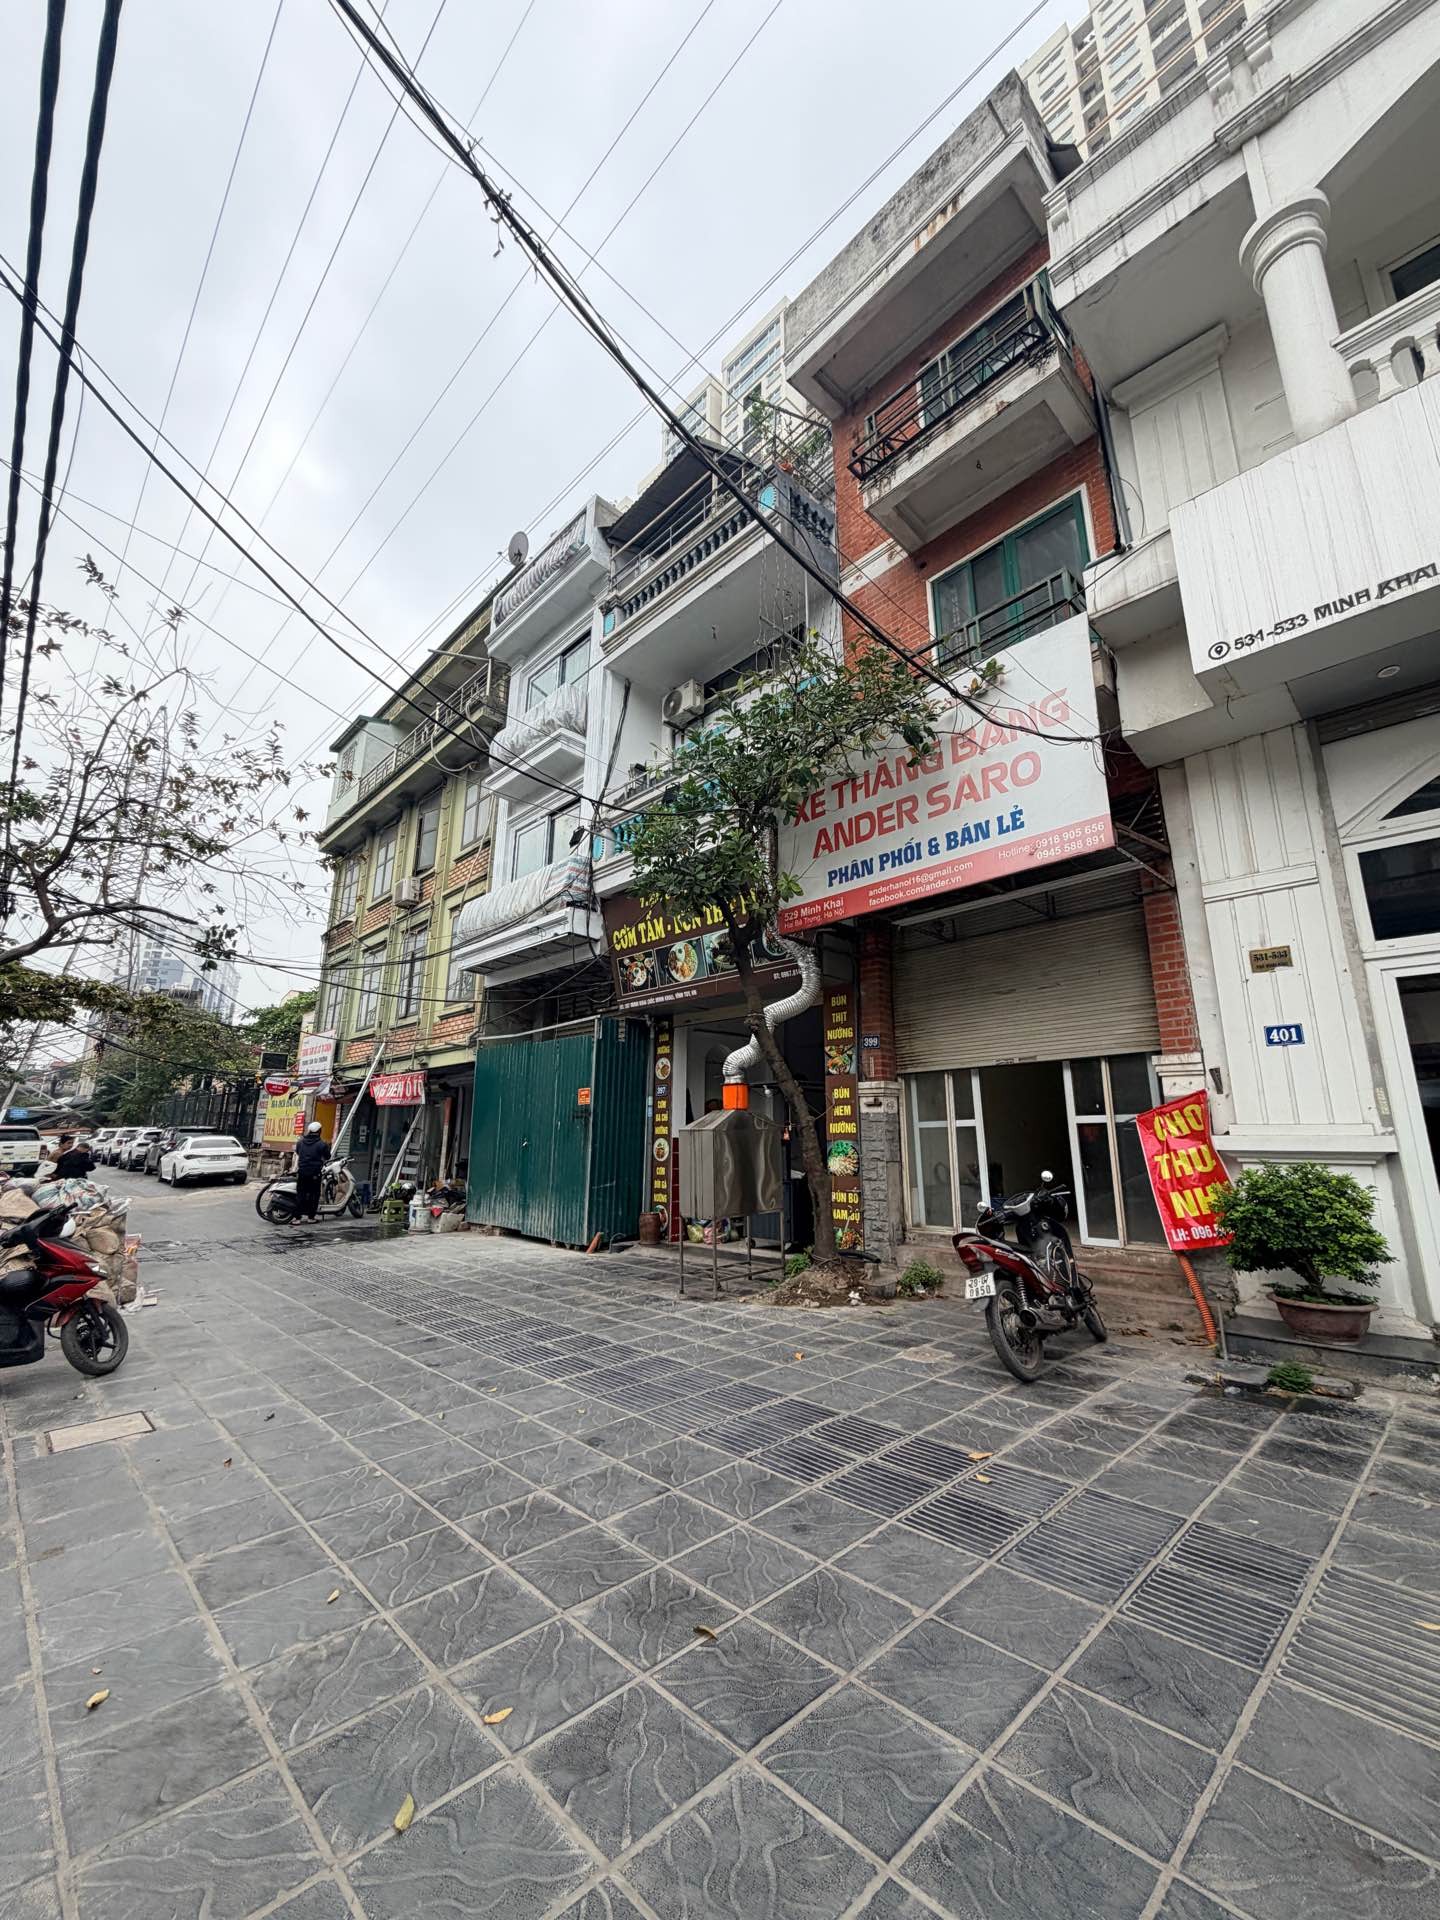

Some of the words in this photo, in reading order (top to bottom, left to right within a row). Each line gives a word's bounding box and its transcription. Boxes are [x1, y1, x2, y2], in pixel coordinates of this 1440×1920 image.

[1234, 613, 1309, 650] 531-533
[1313, 587, 1372, 621] MINH
[1374, 562, 1438, 600] KHAI
[793, 789, 826, 828] XE
[812, 794, 920, 859] ANDER
[927, 751, 1042, 819] SARO
[827, 857, 874, 888] PHÂN
[879, 837, 923, 873] PHỐI
[927, 837, 941, 857] &
[945, 820, 991, 852] BÁN
[996, 804, 1025, 836] LẺ
[800, 904, 821, 917] Minh
[823, 897, 844, 911] Khai
[638, 911, 666, 944] TẤM
[831, 994, 847, 1007] BÚN
[832, 1011, 847, 1024] THỊT
[863, 1037, 878, 1047] 399
[1270, 1027, 1299, 1043] 401
[833, 1085, 850, 1099] BÚN
[833, 1105, 851, 1117] NEM
[1153, 1103, 1204, 1142] CHO
[1170, 1180, 1228, 1219] NH
[1170, 1229, 1190, 1242] LH:
